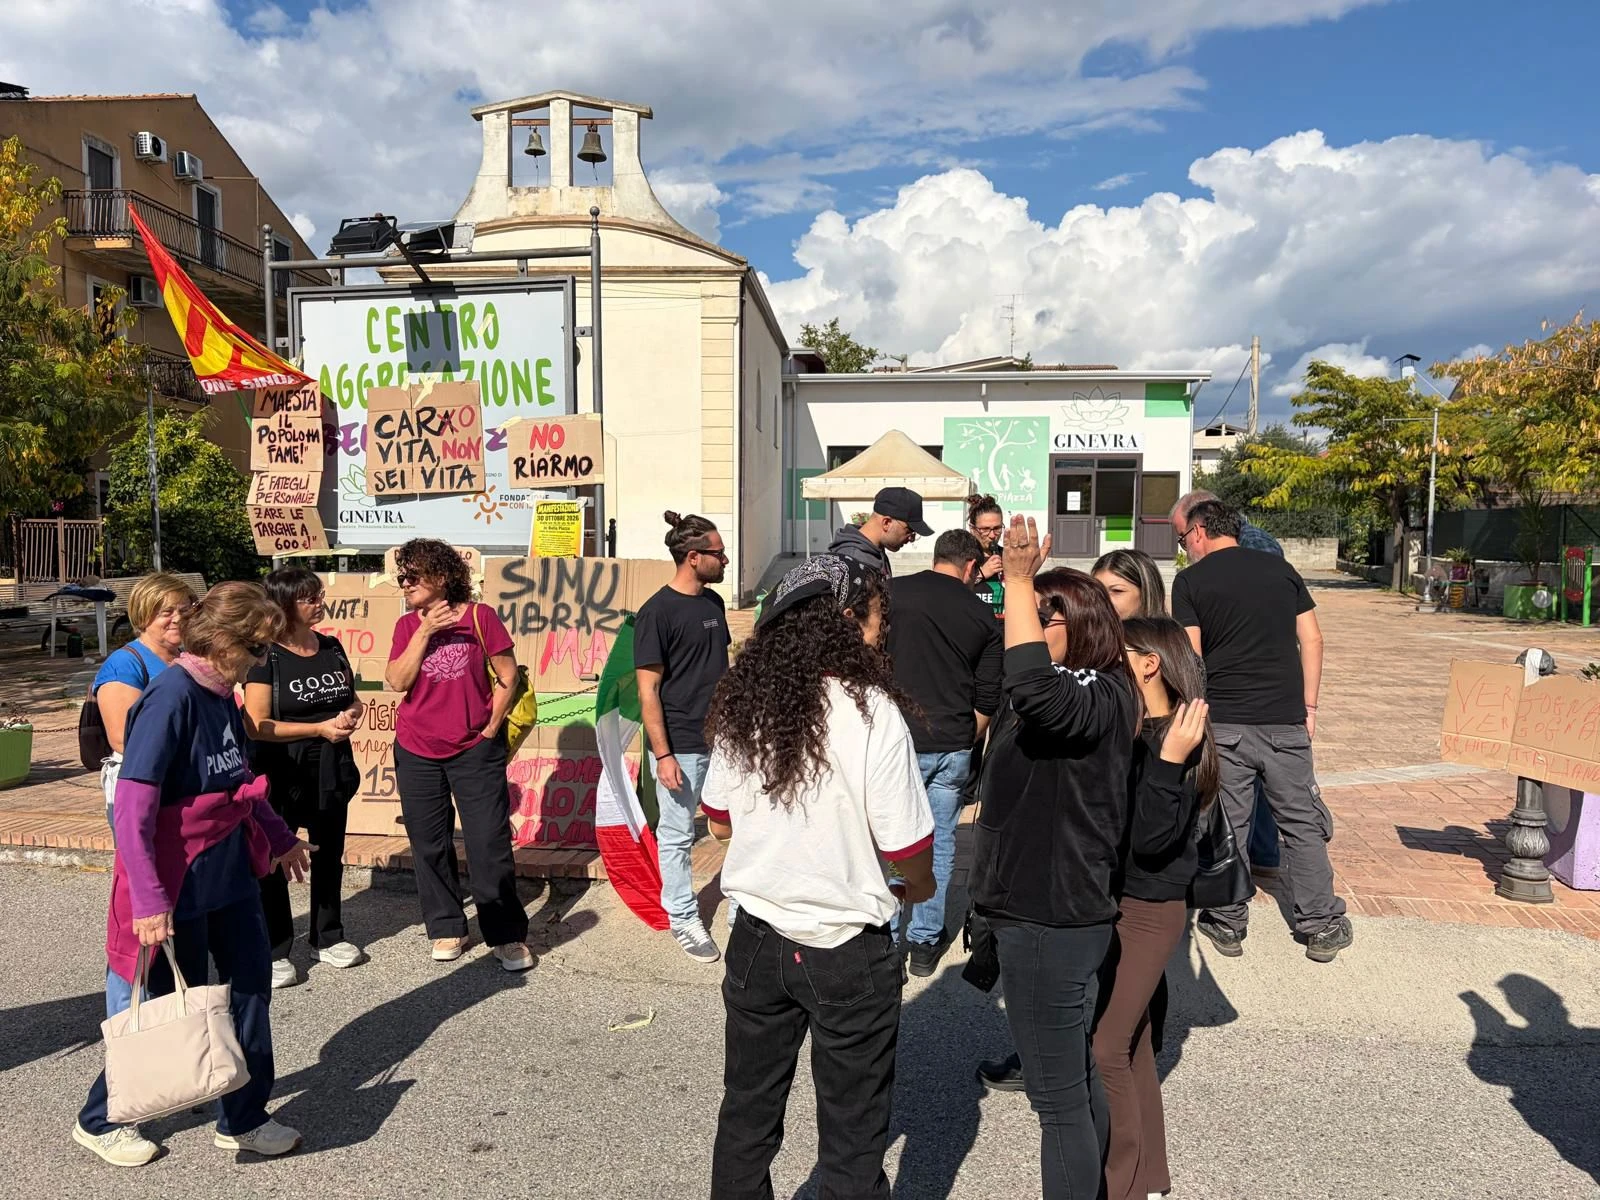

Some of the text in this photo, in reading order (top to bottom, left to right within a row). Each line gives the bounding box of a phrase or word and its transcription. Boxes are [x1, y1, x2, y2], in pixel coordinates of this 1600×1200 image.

[366, 302, 500, 354] CENTRO
[279, 414, 293, 428] IL
[529, 423, 566, 451] NO
[1054, 433, 1138, 449] GINEVRA
[376, 438, 441, 468] VITA,
[374, 464, 477, 493] SEI VITA
[290, 508, 304, 520] LE
[340, 509, 405, 524] GINEVRA
[254, 521, 309, 538] TARGHE A
[275, 538, 299, 551] 600
[499, 557, 619, 612] SIMU
[289, 671, 346, 693] GOOD
